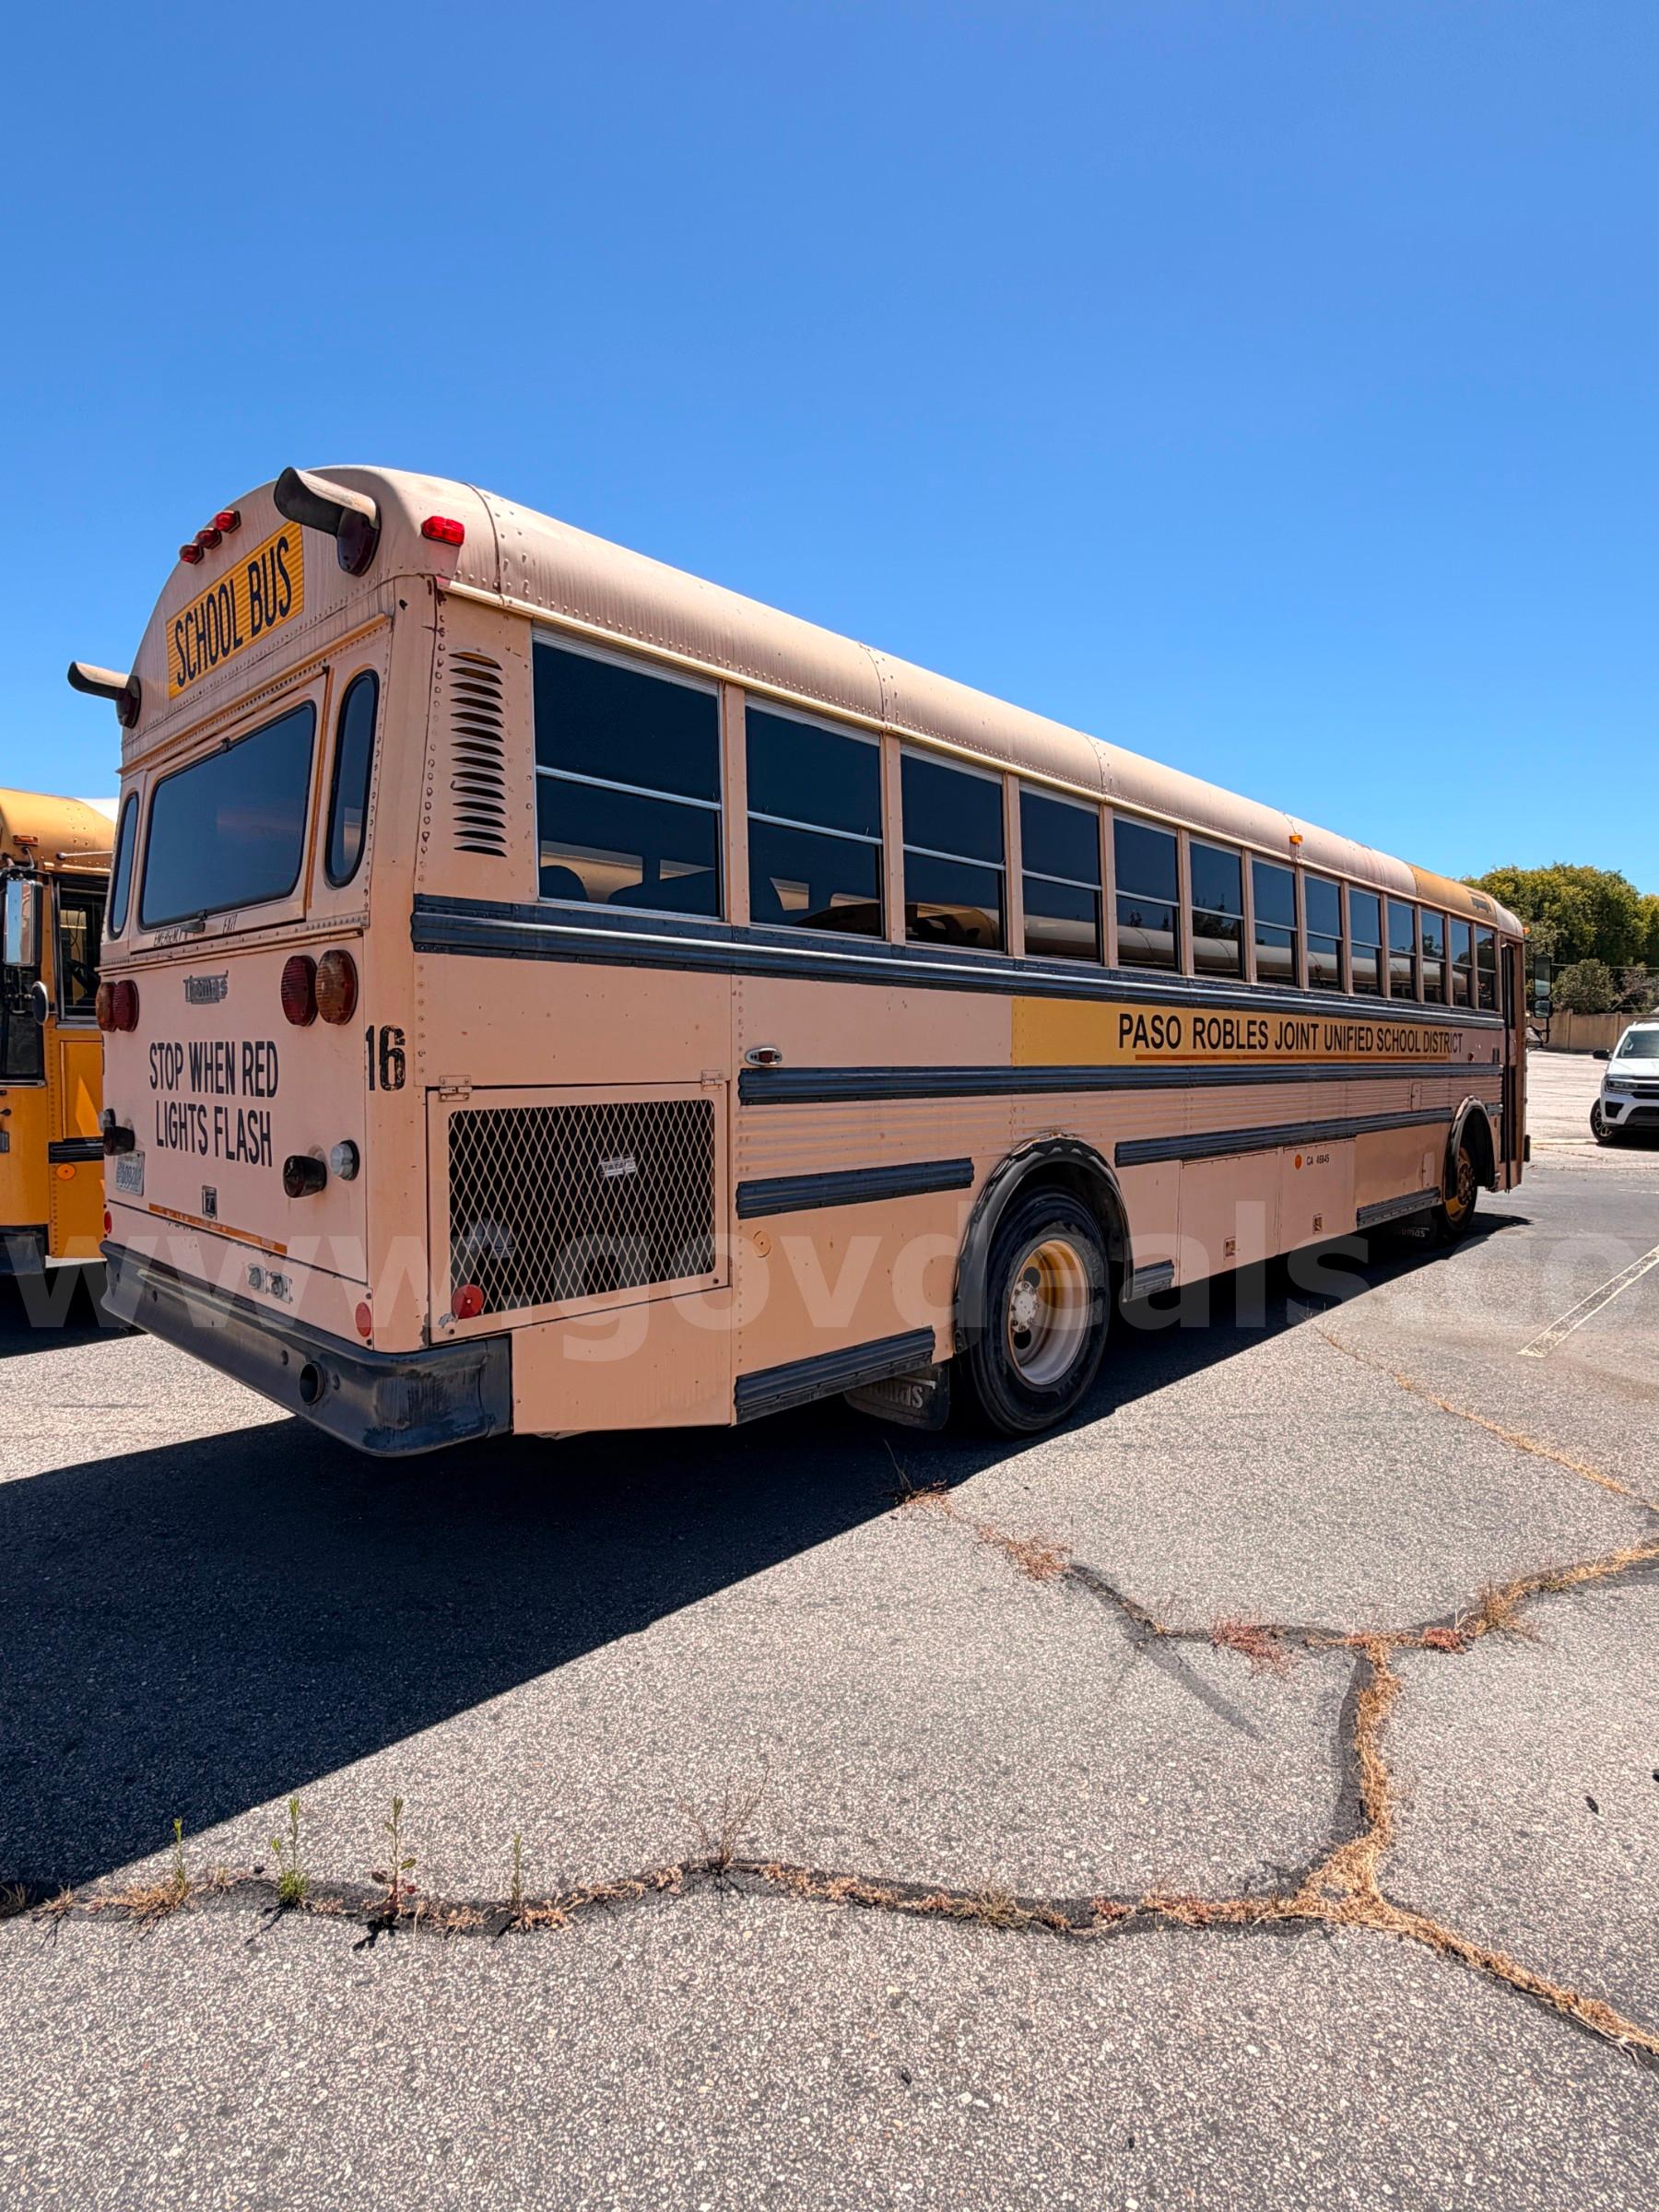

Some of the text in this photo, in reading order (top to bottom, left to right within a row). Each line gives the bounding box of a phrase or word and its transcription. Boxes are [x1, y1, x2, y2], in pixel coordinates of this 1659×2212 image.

[175, 536, 292, 688] SCHOOL BUS
[366, 1025, 406, 1090] 16
[1119, 1013, 1463, 1054] PASO ROBLES JOINT UNIFIED SCHOOL DISTRICT
[149, 1041, 278, 1098] STOP WHEN RED
[156, 1100, 273, 1168] LIGHTS FLASH
[1306, 1156, 1313, 1166] CA
